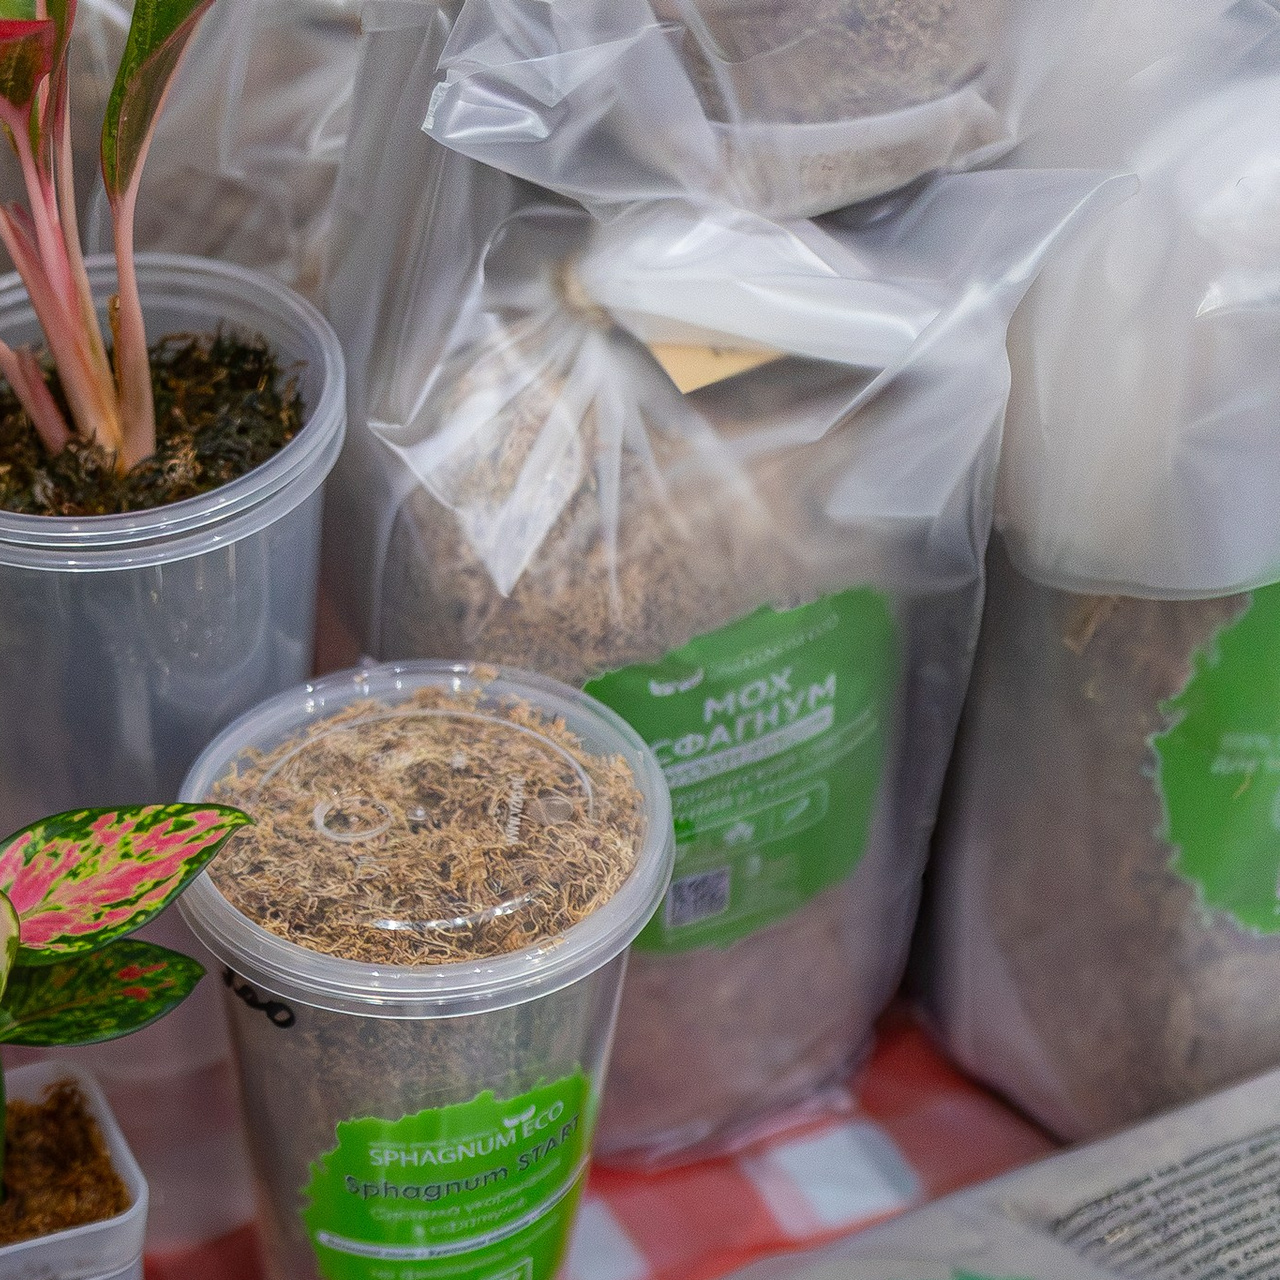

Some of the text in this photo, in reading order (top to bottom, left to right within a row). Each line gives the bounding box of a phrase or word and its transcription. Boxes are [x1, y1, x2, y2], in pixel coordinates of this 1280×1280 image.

[704, 667, 793, 723] МОХ
[345, 1114, 579, 1201] Sphagnum START
[369, 1101, 564, 1167] SPHAGNUM ECO
